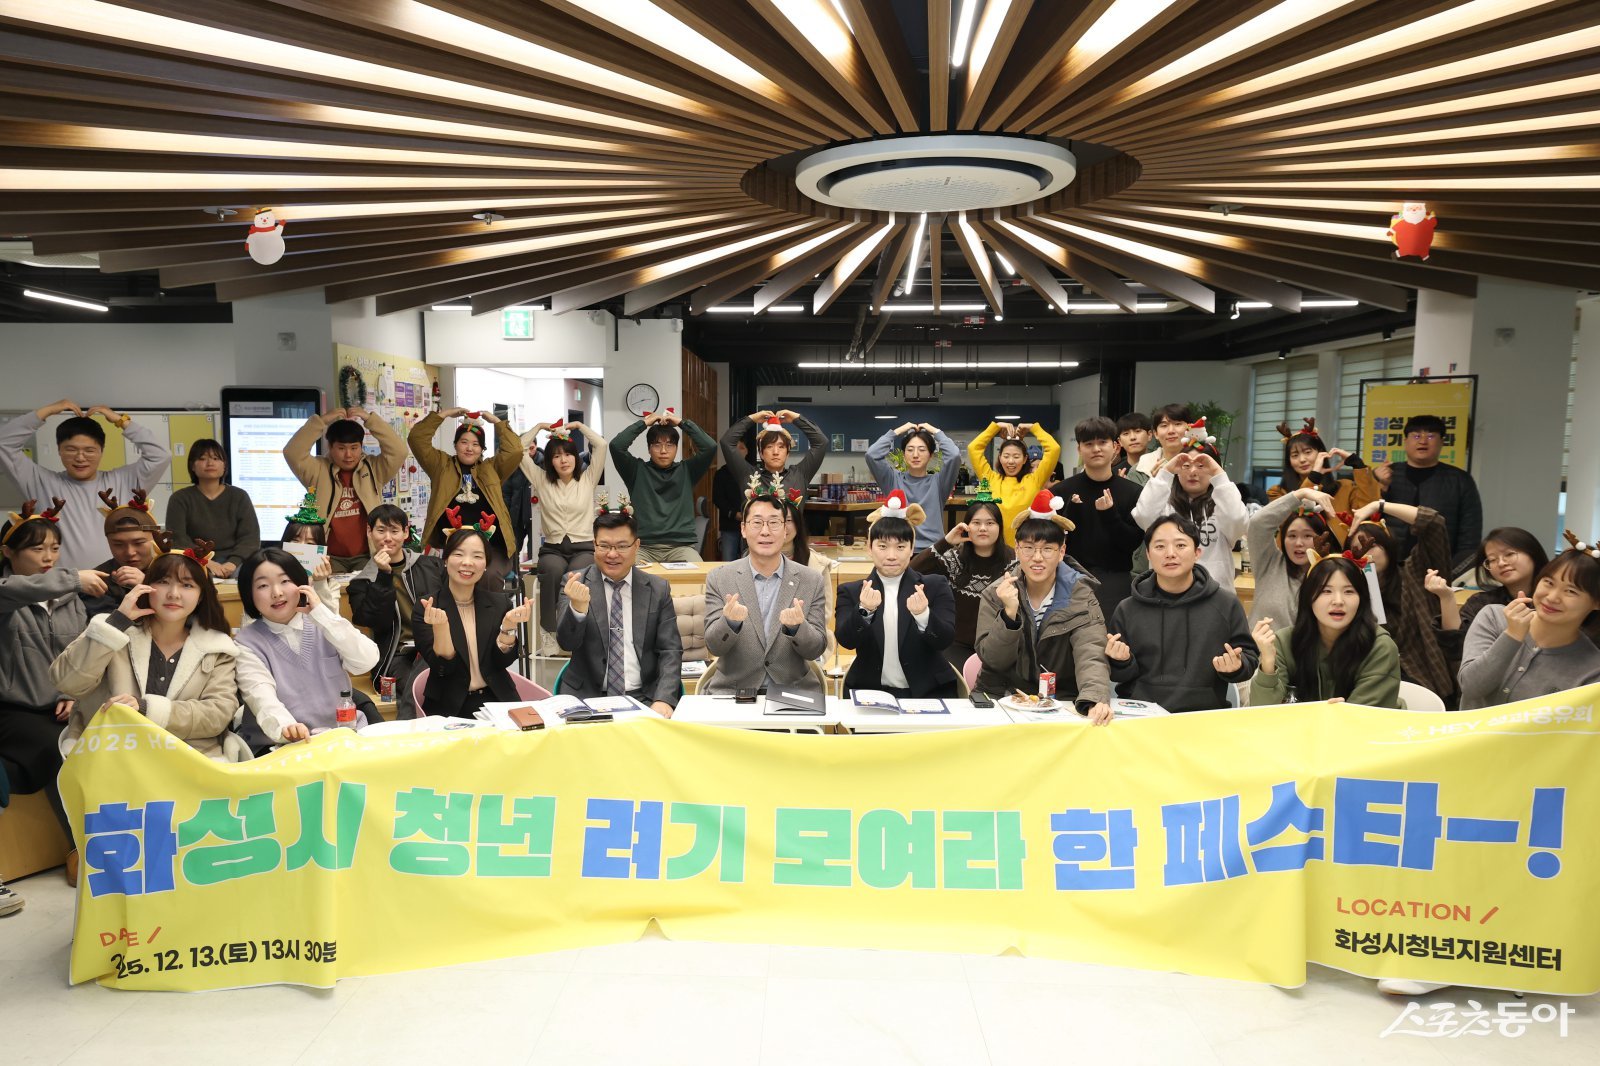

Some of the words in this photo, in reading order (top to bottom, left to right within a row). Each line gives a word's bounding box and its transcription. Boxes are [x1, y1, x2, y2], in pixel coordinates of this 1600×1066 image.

[1429, 720, 1480, 735] HEY
[75, 733, 138, 755] 2025
[84, 780, 366, 898] 화성시
[389, 786, 557, 878] 청년
[581, 797, 746, 883] 려기
[773, 807, 1027, 891] 모여라
[1049, 808, 1138, 891] 한
[1337, 897, 1471, 922] LOCATION
[154, 949, 184, 971] 12.
[262, 939, 300, 961] 13시
[304, 939, 336, 963] 30분
[1335, 928, 1562, 971] 화성시청년지원센터
